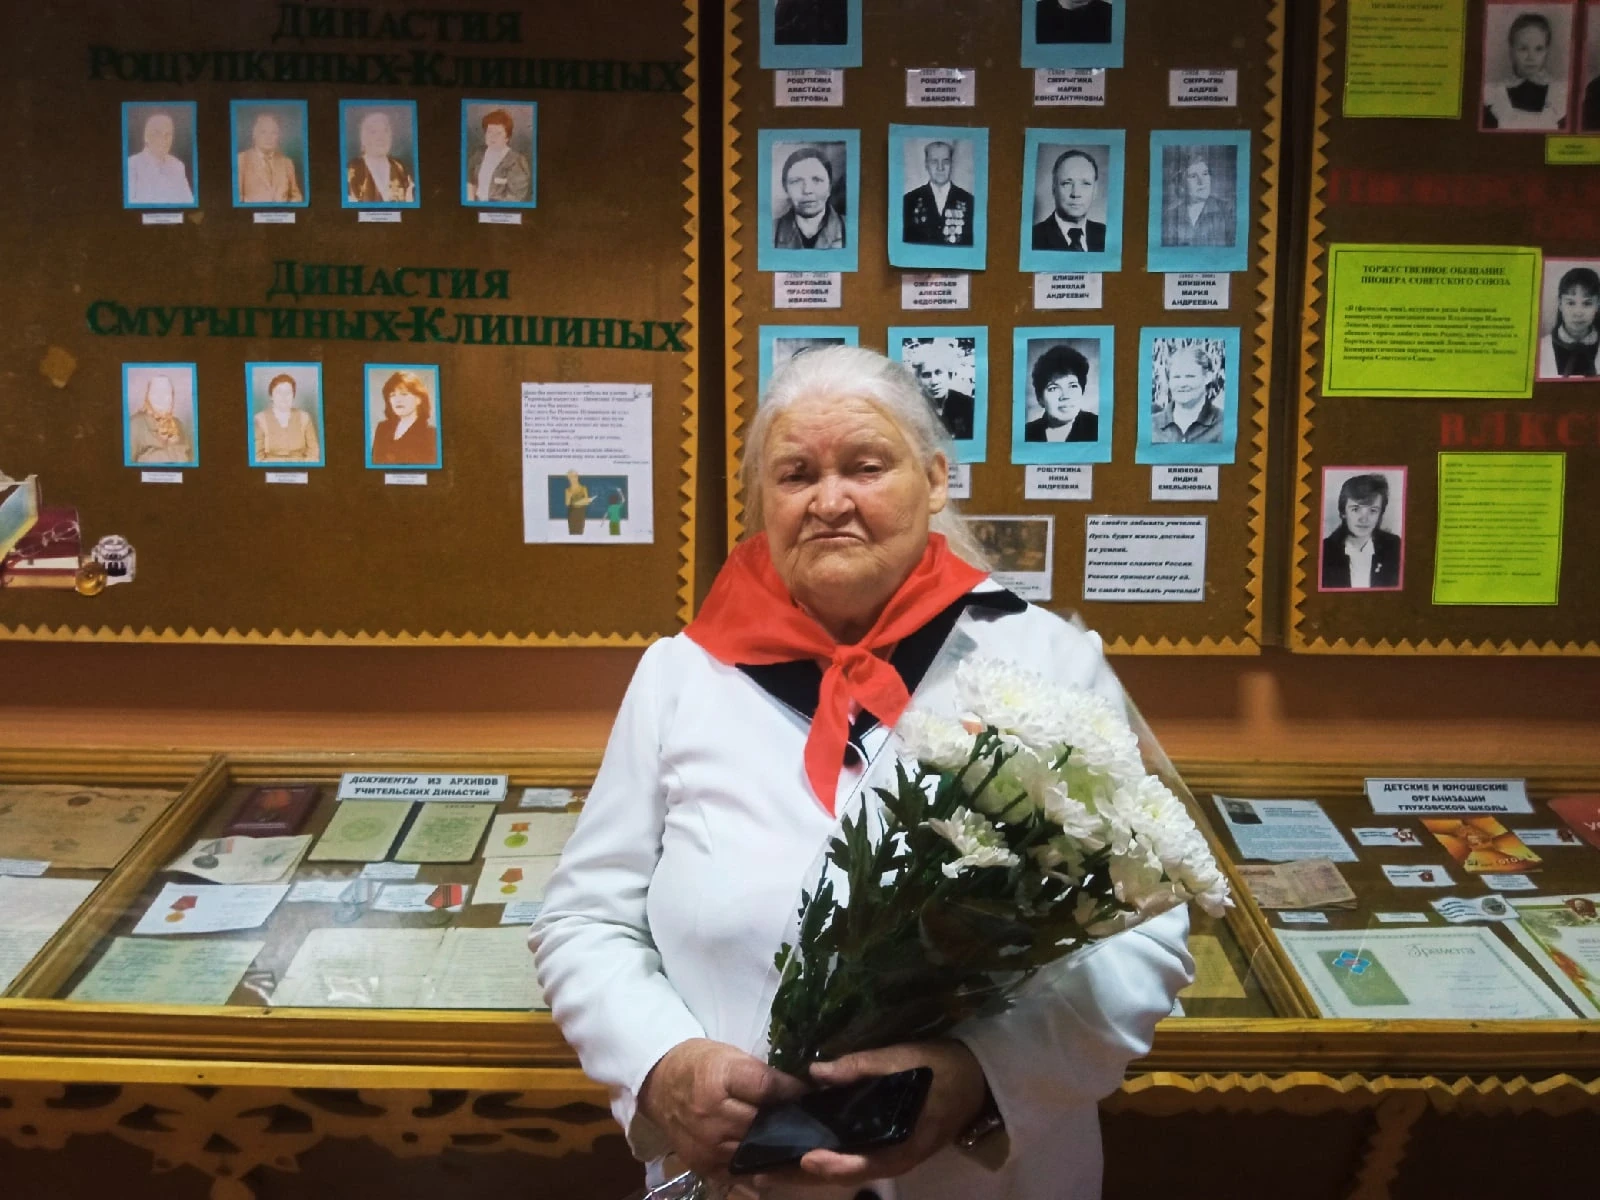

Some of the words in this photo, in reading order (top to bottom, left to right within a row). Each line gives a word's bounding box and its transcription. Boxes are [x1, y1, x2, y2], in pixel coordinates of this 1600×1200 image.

[272, 3, 523, 43] ДИНАСТИЯ
[1363, 265, 1447, 274] ТОРЖЕСТВЕННОЕ
[1450, 267, 1505, 276] ОБЕЩАНИЕ
[266, 260, 511, 301] ДИНАСТИЯ
[1361, 276, 1407, 285] ПИОНЕРА
[1409, 276, 1474, 286] СОВЕТСКОГО
[86, 301, 687, 352] СМУРЫГИНЫХ-КЛИШИНЫХ
[1440, 411, 1600, 446] ВЛКС
[350, 776, 418, 785] ДОКУМЕНТЫ
[354, 787, 429, 796] УЧИТЕЛЬСКИХ
[432, 787, 490, 796] ДИНАСТИЙ
[1384, 783, 1429, 792] ДЕТСКИЕ
[1442, 783, 1508, 791] ЮНОШЕСКИЕ
[1411, 795, 1486, 803] ОРГАНИЗАЦИИ
